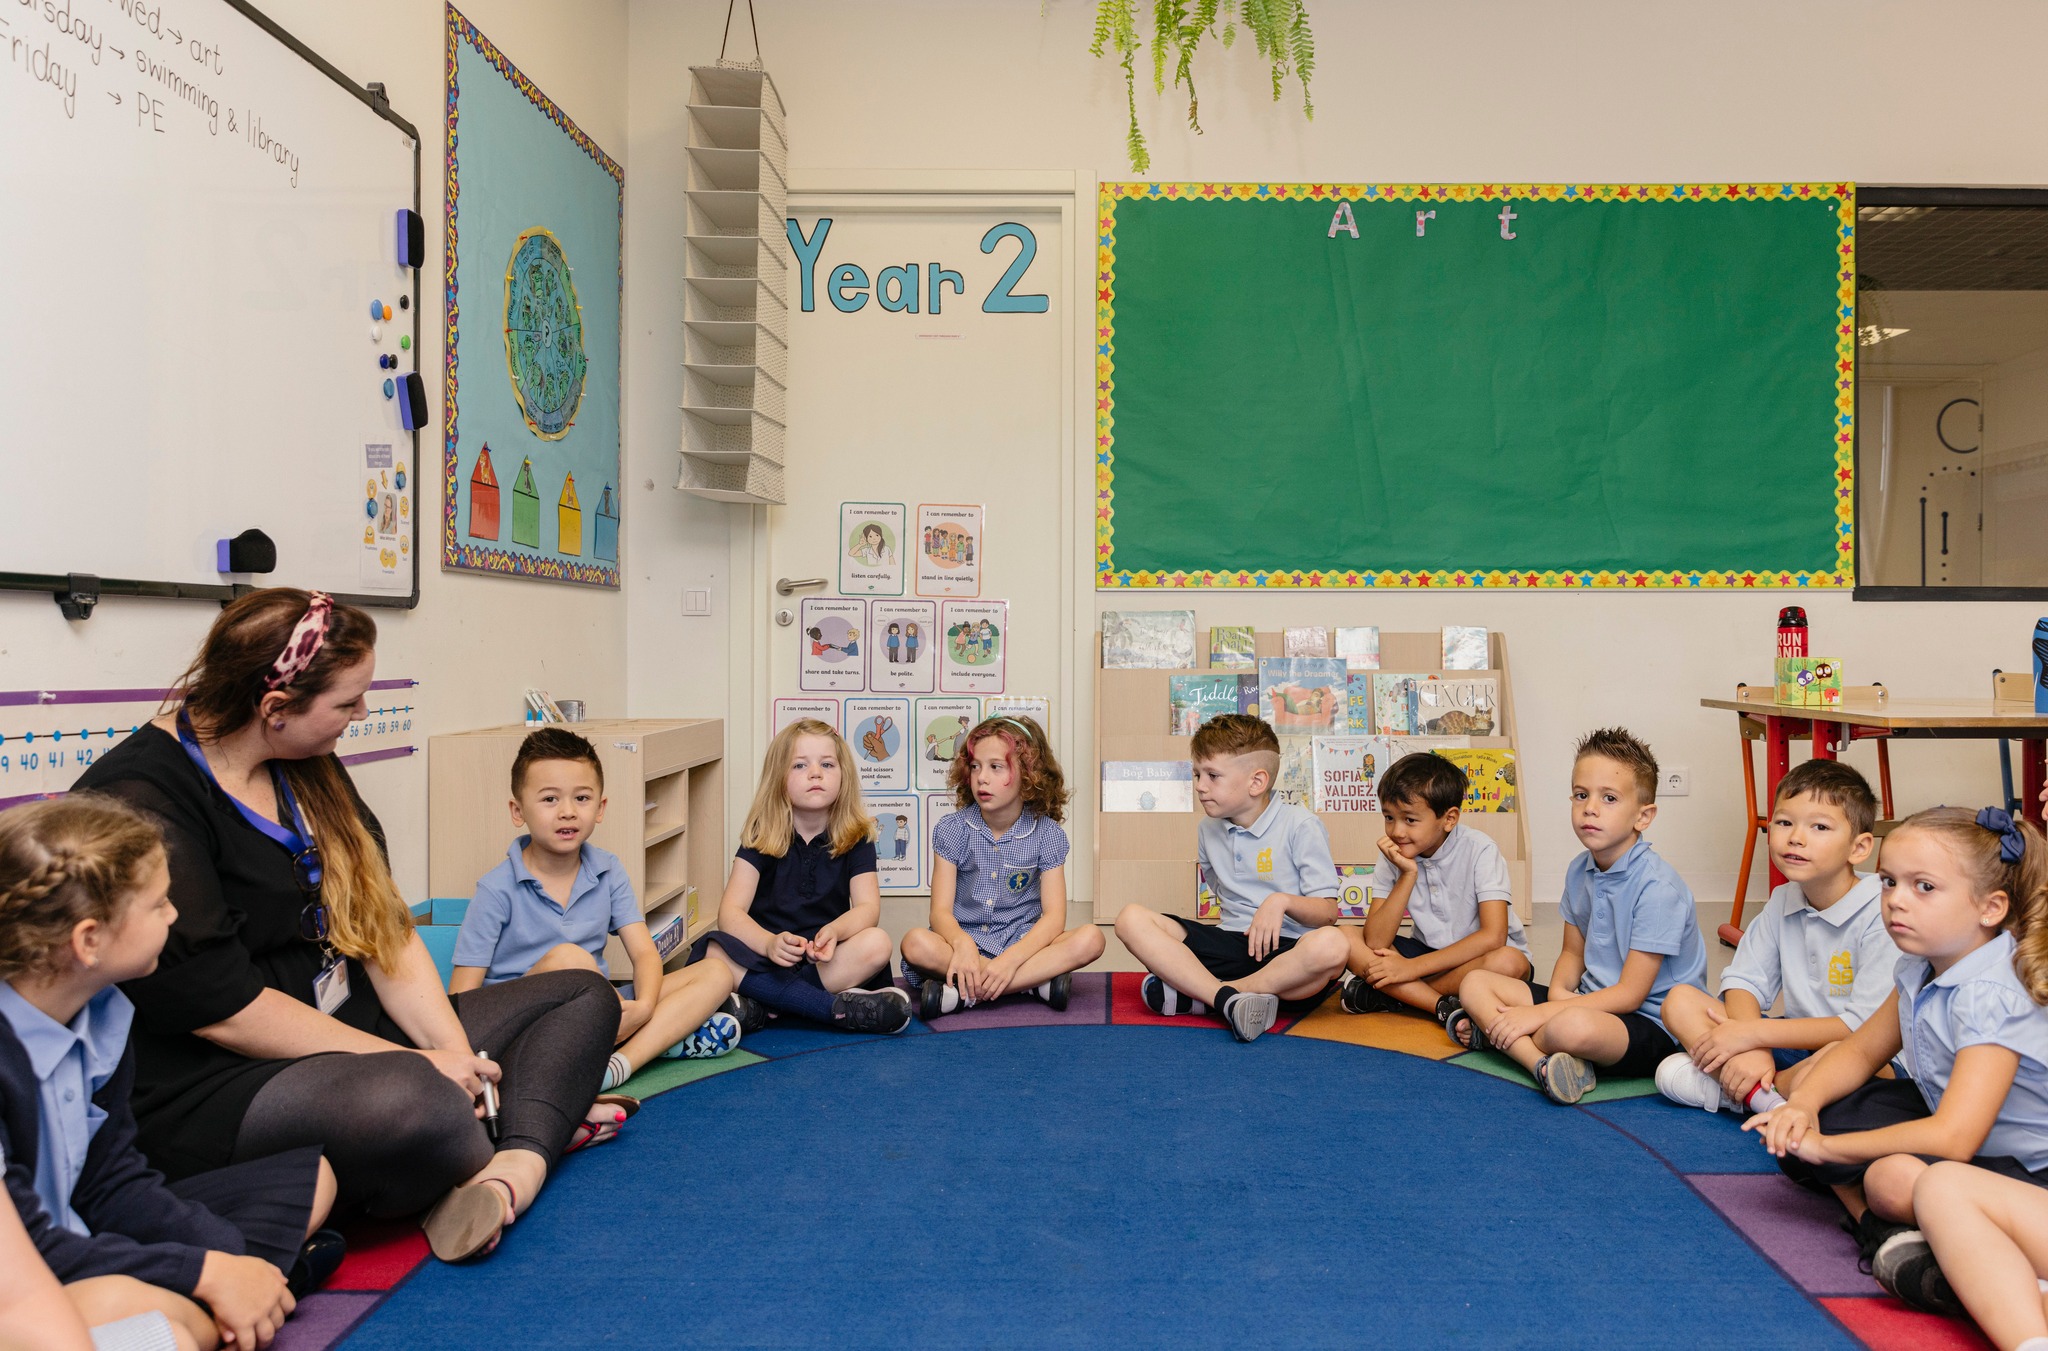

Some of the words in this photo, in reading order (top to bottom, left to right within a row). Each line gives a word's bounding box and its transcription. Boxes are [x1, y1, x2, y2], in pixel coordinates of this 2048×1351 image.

[189, 39, 224, 76] art
[18, 0, 103, 66] sday
[136, 49, 219, 136] swimming
[227, 107, 239, 134] &
[247, 109, 299, 189] library
[137, 91, 166, 134] PE
[786, 217, 966, 316] Year
[979, 221, 1051, 314] 2
[867, 573, 892, 581] carefully.
[955, 575, 975, 583] quietly.
[1216, 627, 1250, 643] Roald
[1777, 632, 1802, 646] RUN
[1777, 646, 1802, 658] AND
[897, 670, 915, 678] polite.
[972, 672, 997, 680] everyone.
[1268, 669, 1288, 678] Willy
[1304, 669, 1339, 678] Dreamer
[349, 725, 360, 738] 56
[363, 723, 374, 736] 57
[376, 721, 387, 734] 58
[390, 720, 400, 733] 59
[402, 718, 412, 731] 60
[20, 753, 39, 771] 40
[48, 751, 64, 769] 41
[75, 748, 94, 766] 42
[1123, 768, 1143, 779] Bog
[1147, 767, 1173, 779] Baby
[1324, 770, 1363, 782] SOFIA
[1324, 784, 1377, 797] VALDEZ,
[1324, 799, 1377, 812] FUTURE
